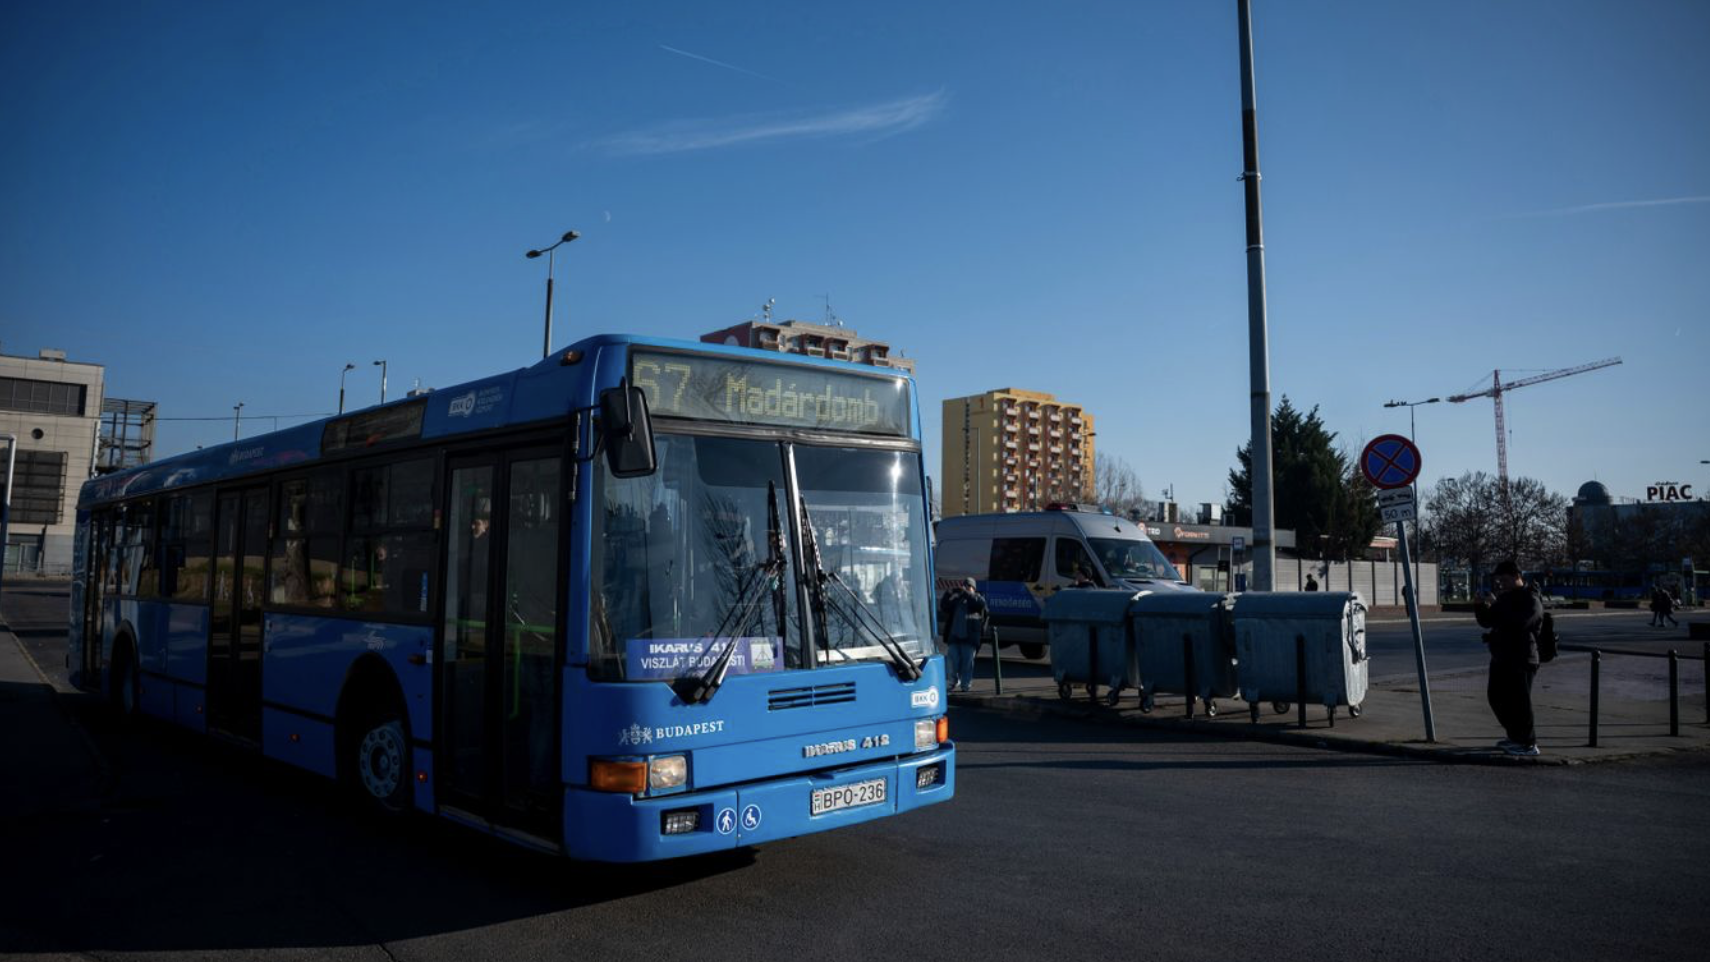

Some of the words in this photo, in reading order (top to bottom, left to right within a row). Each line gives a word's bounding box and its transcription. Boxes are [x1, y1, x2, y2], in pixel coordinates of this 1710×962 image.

[633, 360, 691, 412] 67
[725, 372, 879, 425] Madárdomb
[1647, 485, 1692, 501] PIAC
[1384, 509, 1399, 519] 50
[650, 643, 704, 654] IKARUS
[711, 641, 738, 653] 41
[641, 655, 686, 670] VISZLÁT
[656, 720, 725, 739] BUDAPEST
[803, 739, 857, 758] IKARUS
[861, 734, 890, 749] 412
[823, 783, 884, 809] BPO-236
